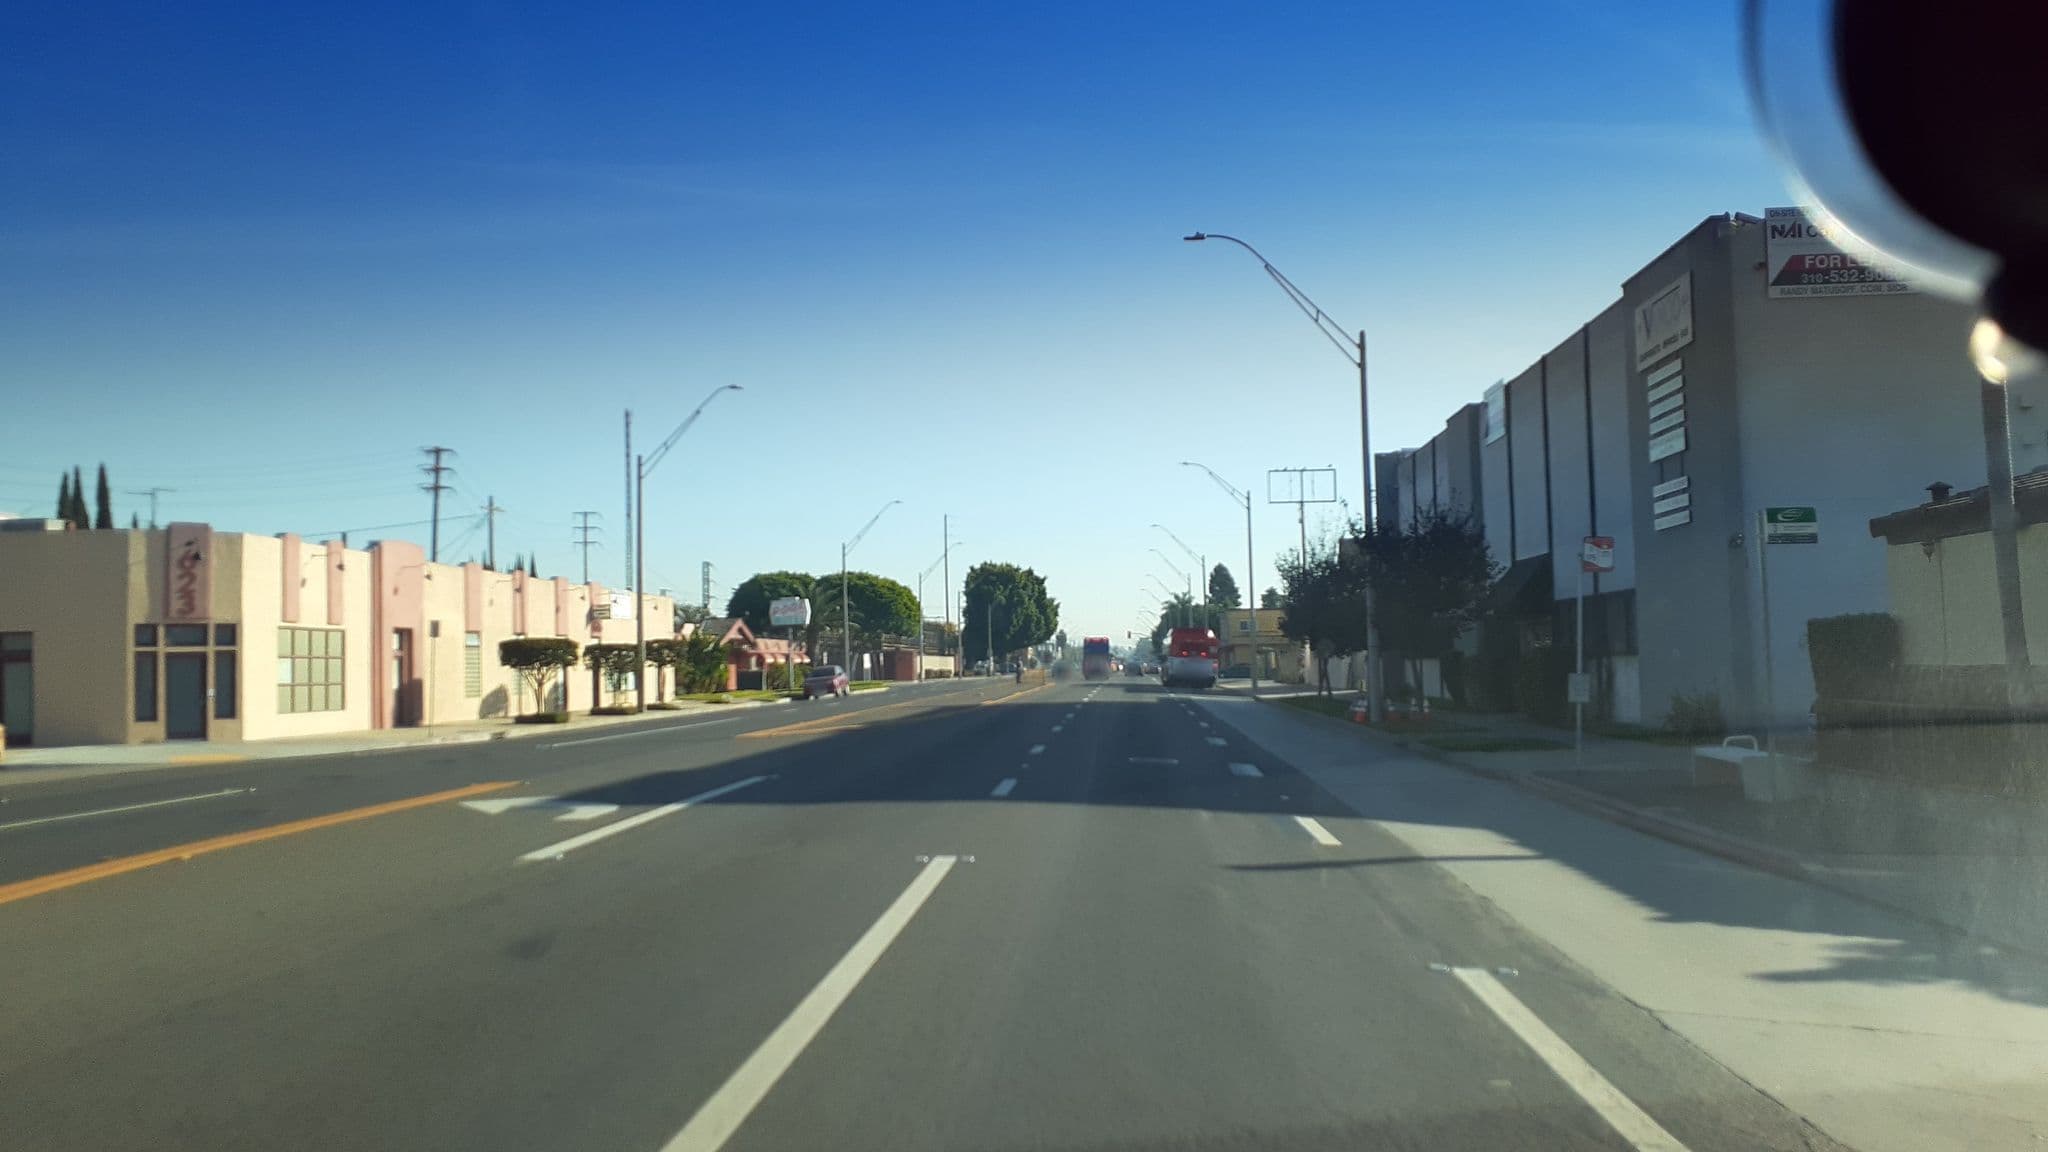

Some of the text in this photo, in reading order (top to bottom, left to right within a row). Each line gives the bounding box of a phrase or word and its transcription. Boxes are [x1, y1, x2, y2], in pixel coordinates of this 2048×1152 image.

[1771, 221, 1802, 239] NAI
[1805, 255, 1841, 268] FOR
[1801, 268, 1894, 283] 310-532-90
